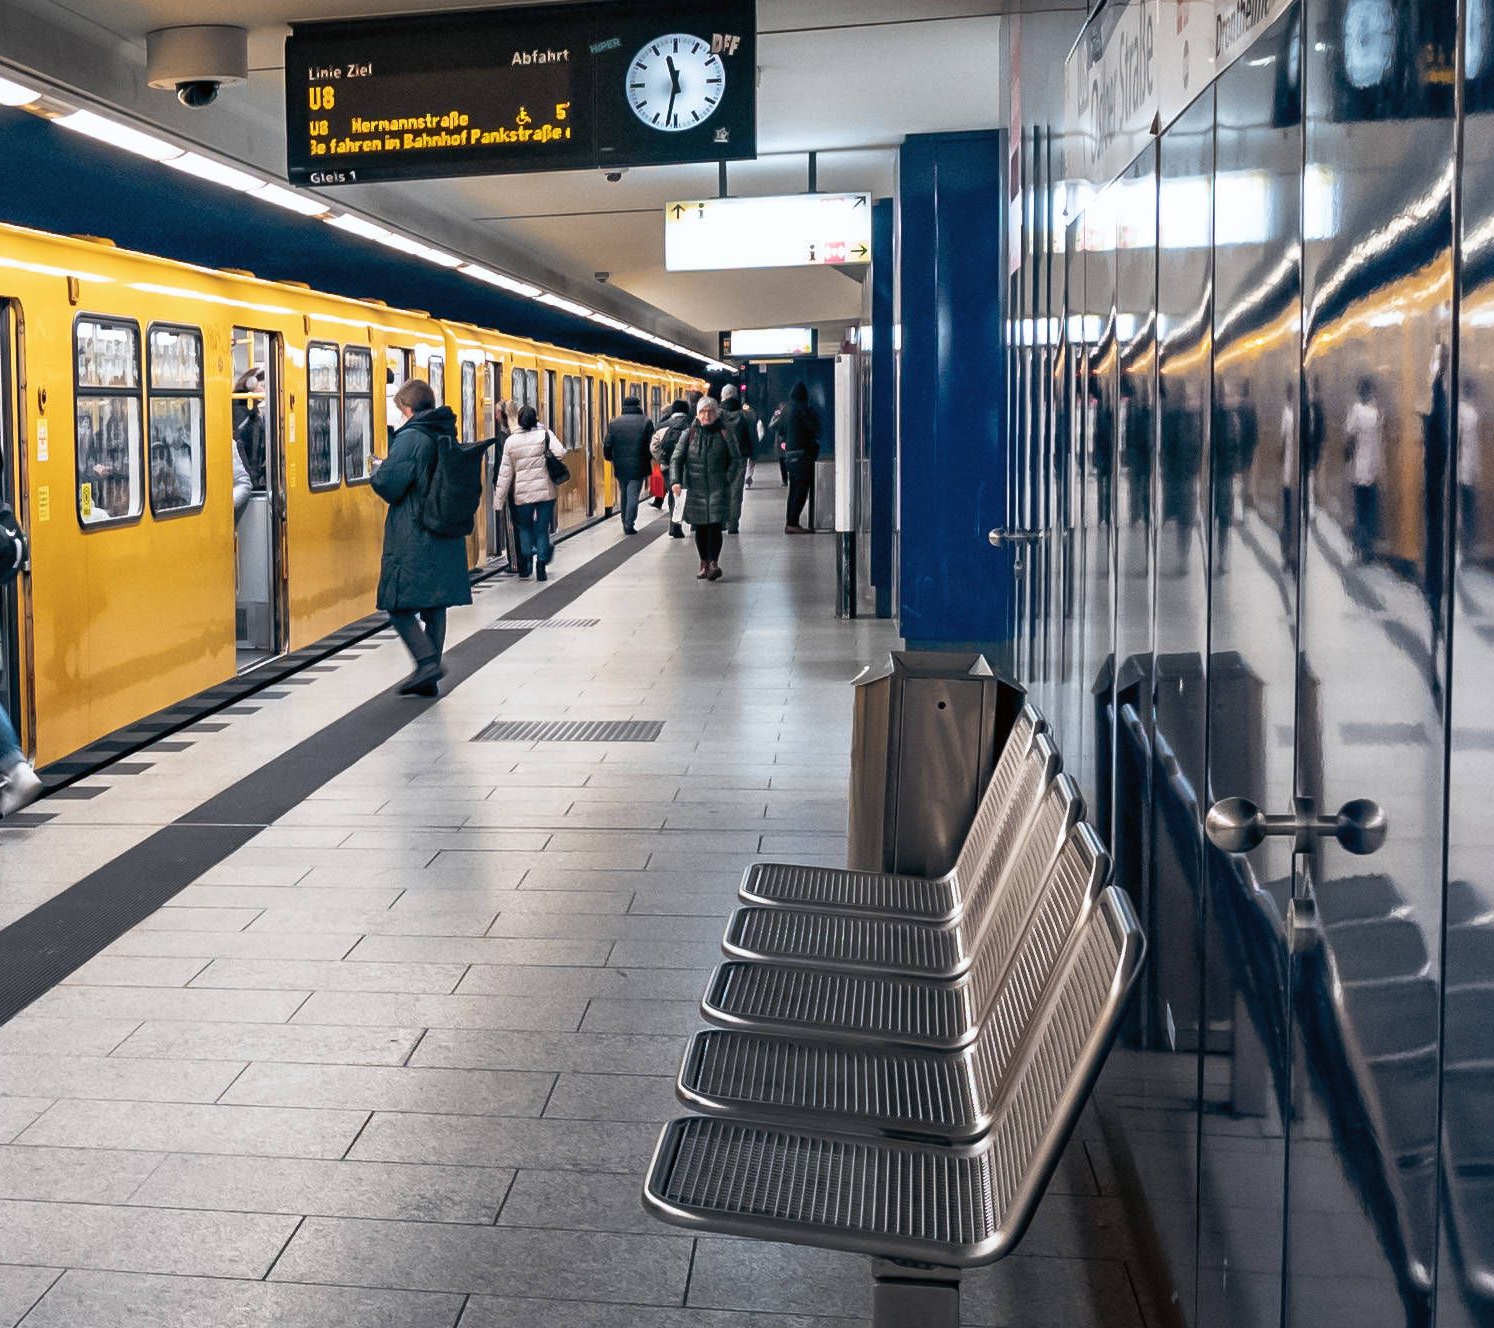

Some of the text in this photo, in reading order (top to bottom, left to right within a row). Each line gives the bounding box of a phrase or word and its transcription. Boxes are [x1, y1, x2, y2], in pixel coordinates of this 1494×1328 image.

[511, 48, 570, 66] Abfahrt
[308, 63, 373, 81] Linie Ziel
[308, 85, 335, 111] U8
[309, 120, 329, 137] U8
[351, 110, 469, 134] Hermannstraße
[329, 136, 383, 155] fahren
[385, 134, 401, 150] in
[403, 130, 468, 149] Bahnhof
[470, 124, 562, 144] Pankstraße
[310, 170, 357, 184] Gleis 1
